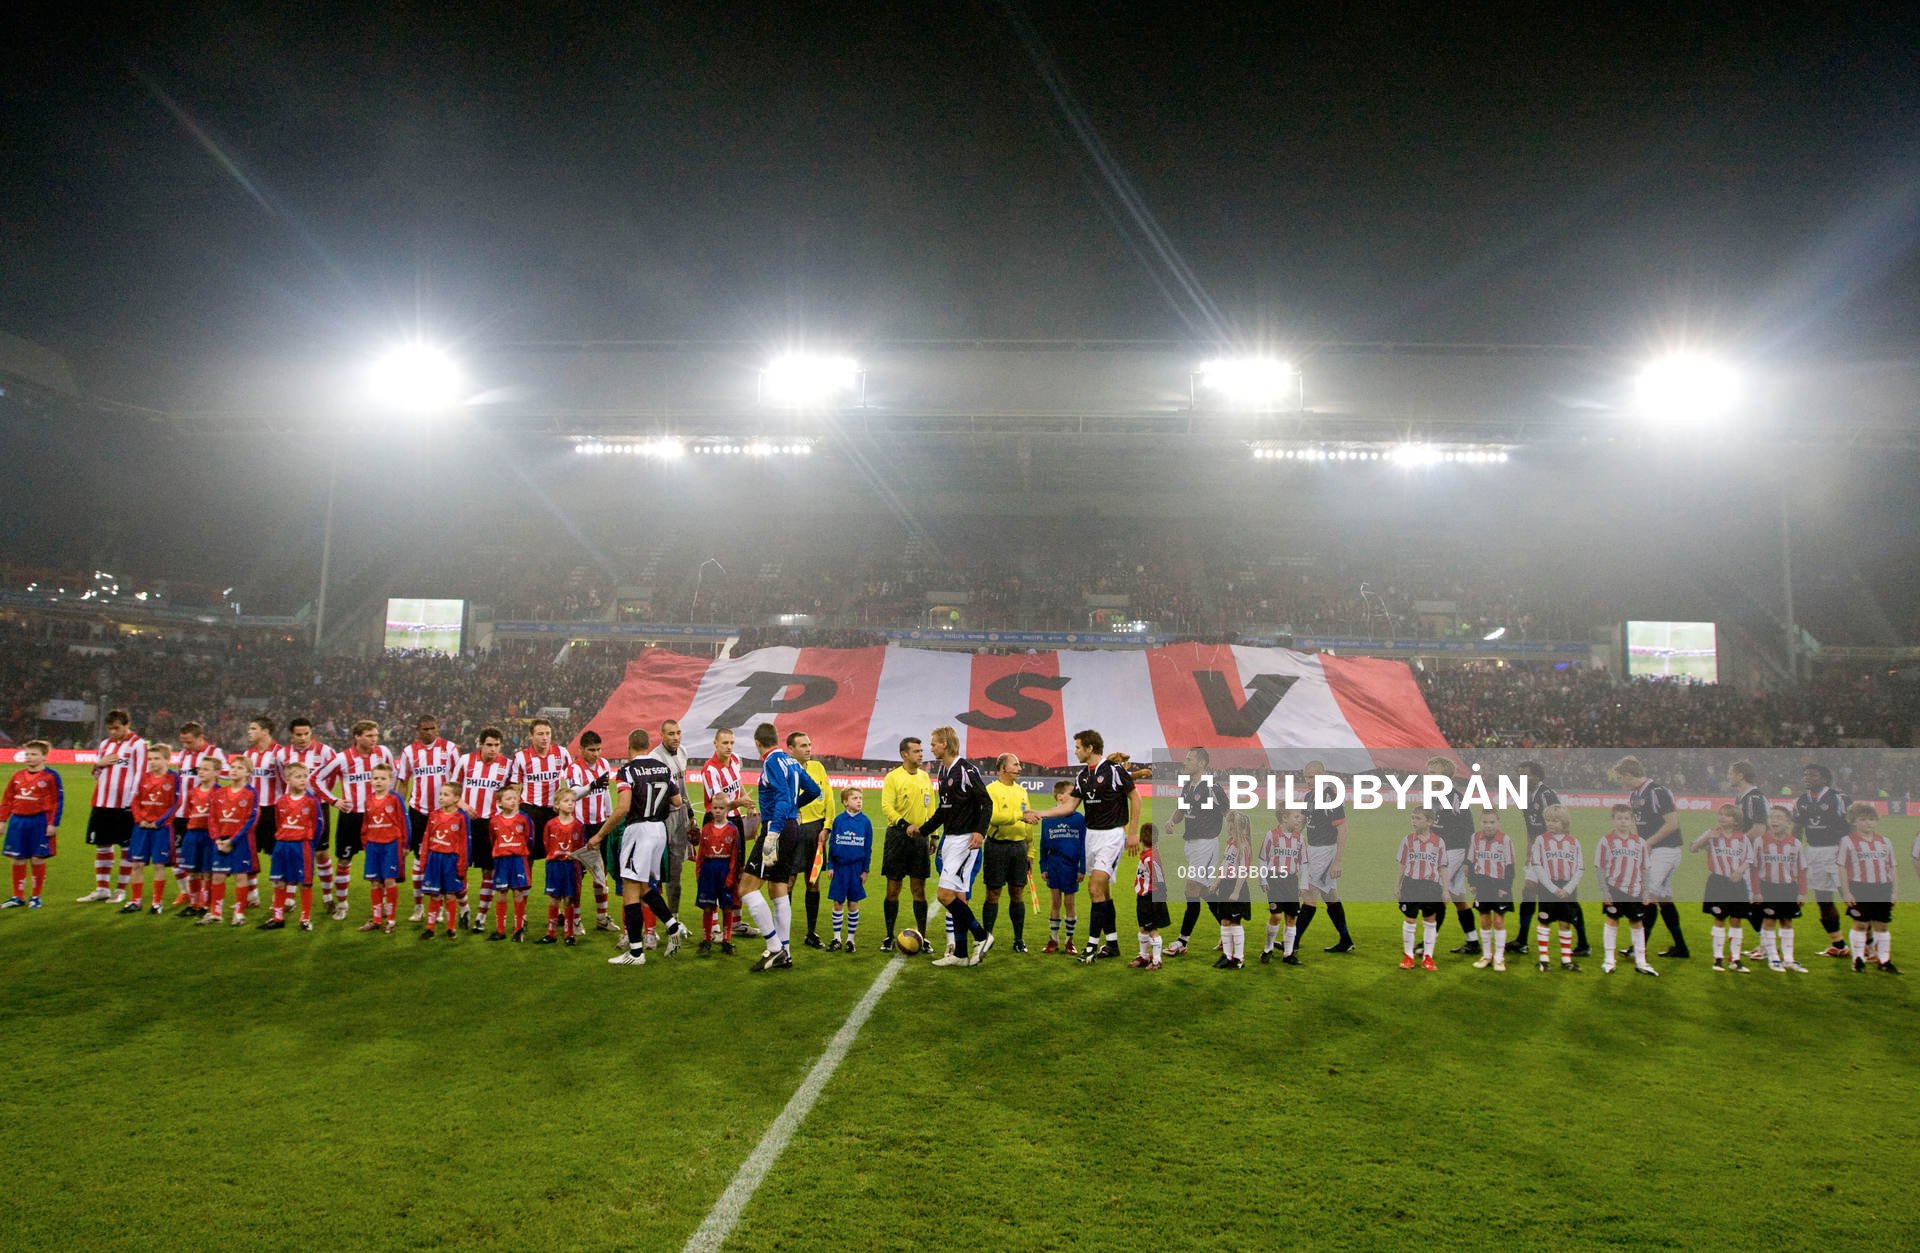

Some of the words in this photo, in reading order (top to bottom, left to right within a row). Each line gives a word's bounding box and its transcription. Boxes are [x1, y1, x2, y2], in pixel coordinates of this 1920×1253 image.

[414, 766, 446, 775] PHILIPS
[349, 772, 371, 781] PHIL
[466, 779, 501, 789] PHILIPS
[722, 781, 740, 793] PHIL
[829, 777, 884, 788] ww.welko
[1020, 781, 1044, 791] CUP
[643, 781, 669, 818] 17
[342, 846, 352, 858] 5
[1273, 849, 1297, 857] PHILIP
[1545, 852, 1575, 861] PHILIPS
[1611, 849, 1639, 859] PHILIPS
[1408, 852, 1437, 863] PHILIPS
